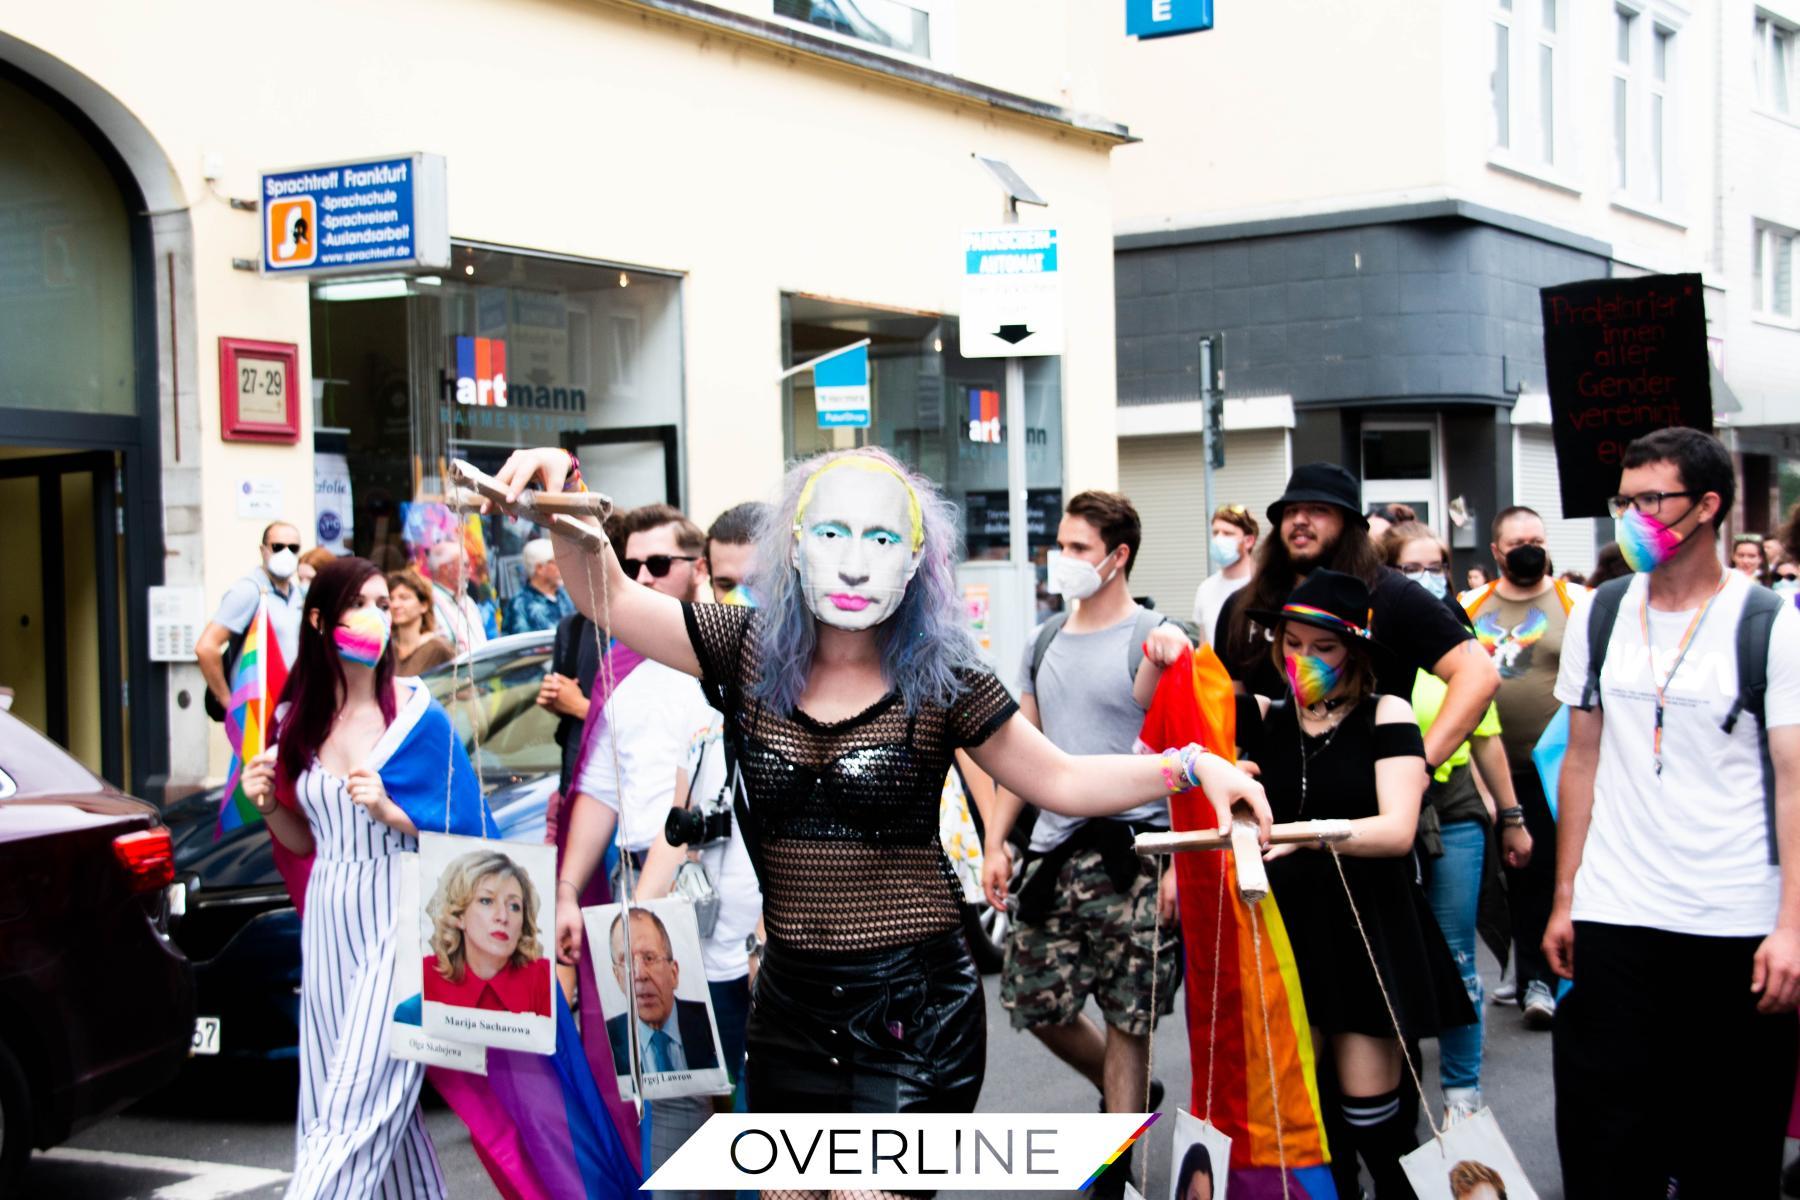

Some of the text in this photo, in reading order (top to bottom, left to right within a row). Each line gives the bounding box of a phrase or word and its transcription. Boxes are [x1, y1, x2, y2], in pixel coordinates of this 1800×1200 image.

[266, 164, 407, 197] Sprachtreff Frankfurt
[321, 246, 410, 263] www.sprachtreff.de
[439, 369, 587, 411] hartmann
[1577, 369, 1677, 400] Gender
[445, 1016, 531, 1036] Marija Sacharowa
[661, 1073, 692, 1082] Lawrow
